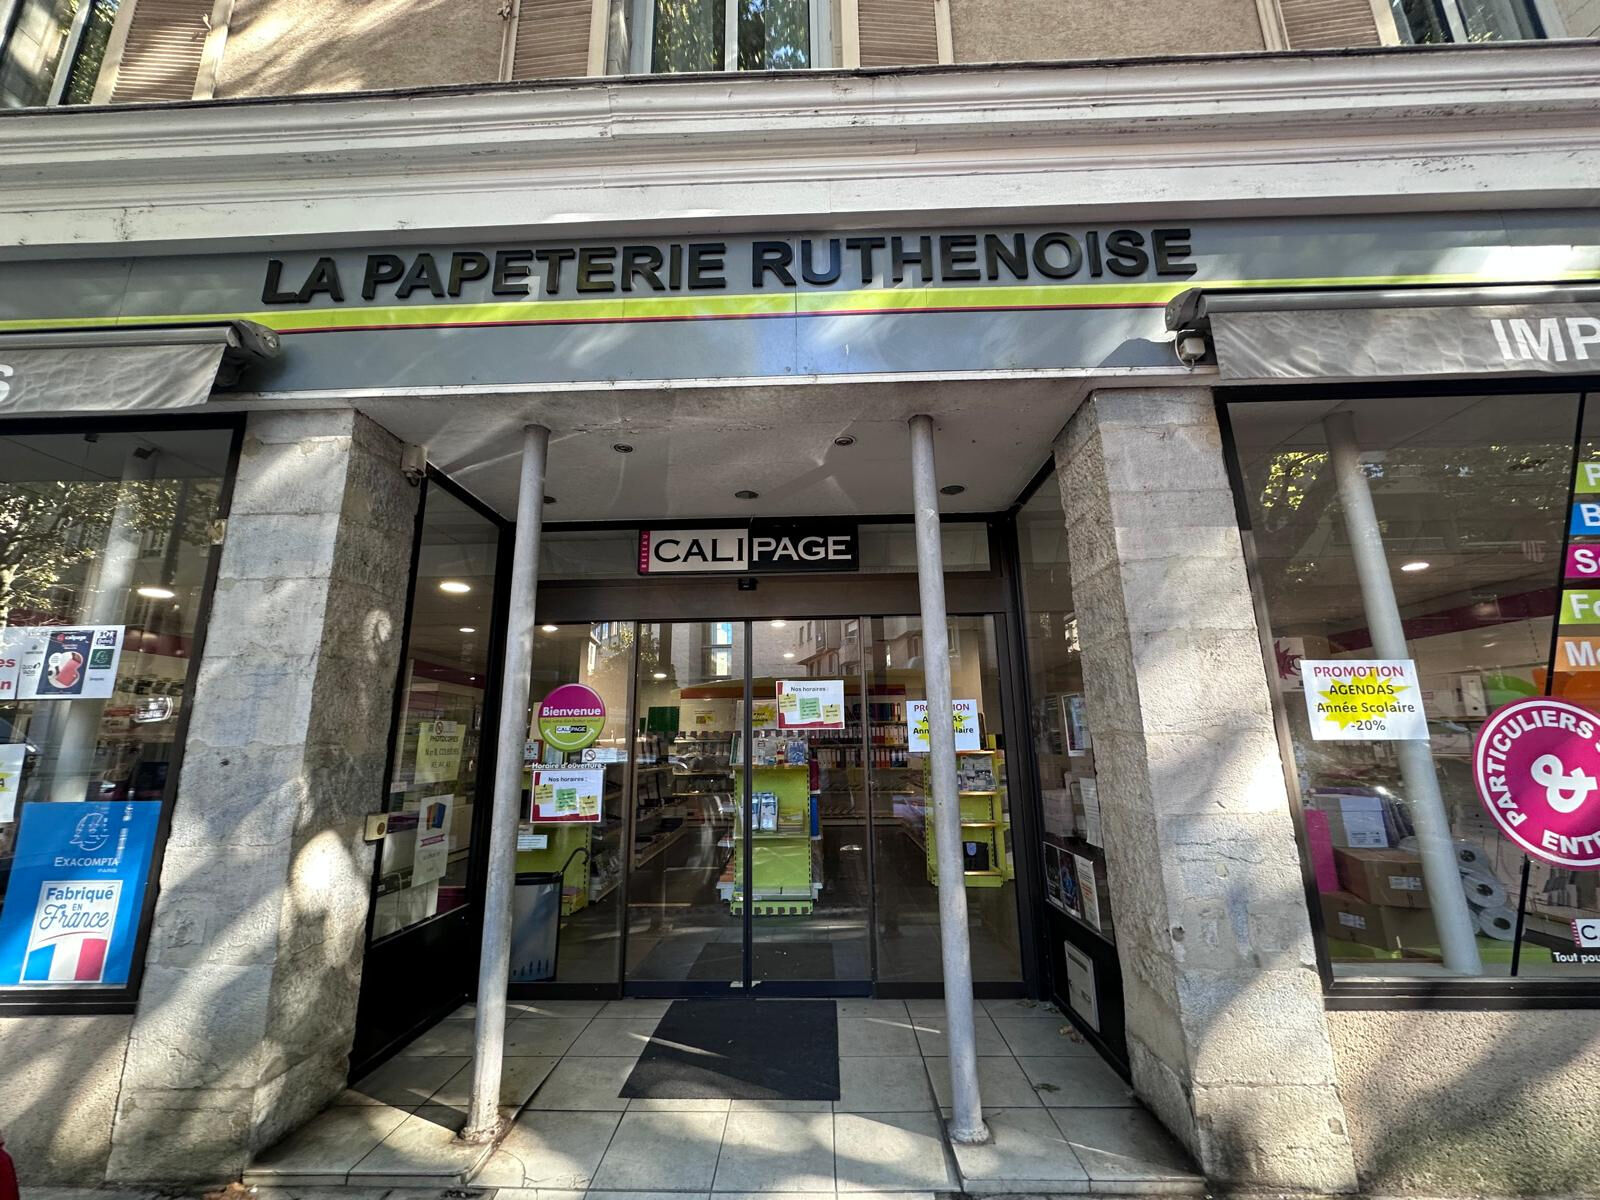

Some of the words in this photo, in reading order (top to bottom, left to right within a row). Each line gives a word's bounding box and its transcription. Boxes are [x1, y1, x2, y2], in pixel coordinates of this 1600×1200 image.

[262, 256, 345, 304] LA
[361, 243, 726, 300] PAPETERIE
[752, 228, 1197, 287] RUTHENOISE
[1490, 317, 1600, 361] IMP
[1574, 548, 1600, 574] S
[1313, 666, 1404, 677] PROMOTION
[1329, 684, 1394, 695] AGENDAS
[542, 706, 601, 716] Bienvenue
[1317, 702, 1358, 713] Année
[1361, 702, 1415, 713] Scolaire
[1351, 720, 1386, 731] -20%
[1487, 710, 1594, 827] PARTICULIERS
[54, 857, 119, 867] EXACOMPTA
[46, 885, 115, 902] Fabriqué
[72, 903, 83, 912] EN
[40, 904, 110, 930] France
[1553, 952, 1578, 962] Tout
